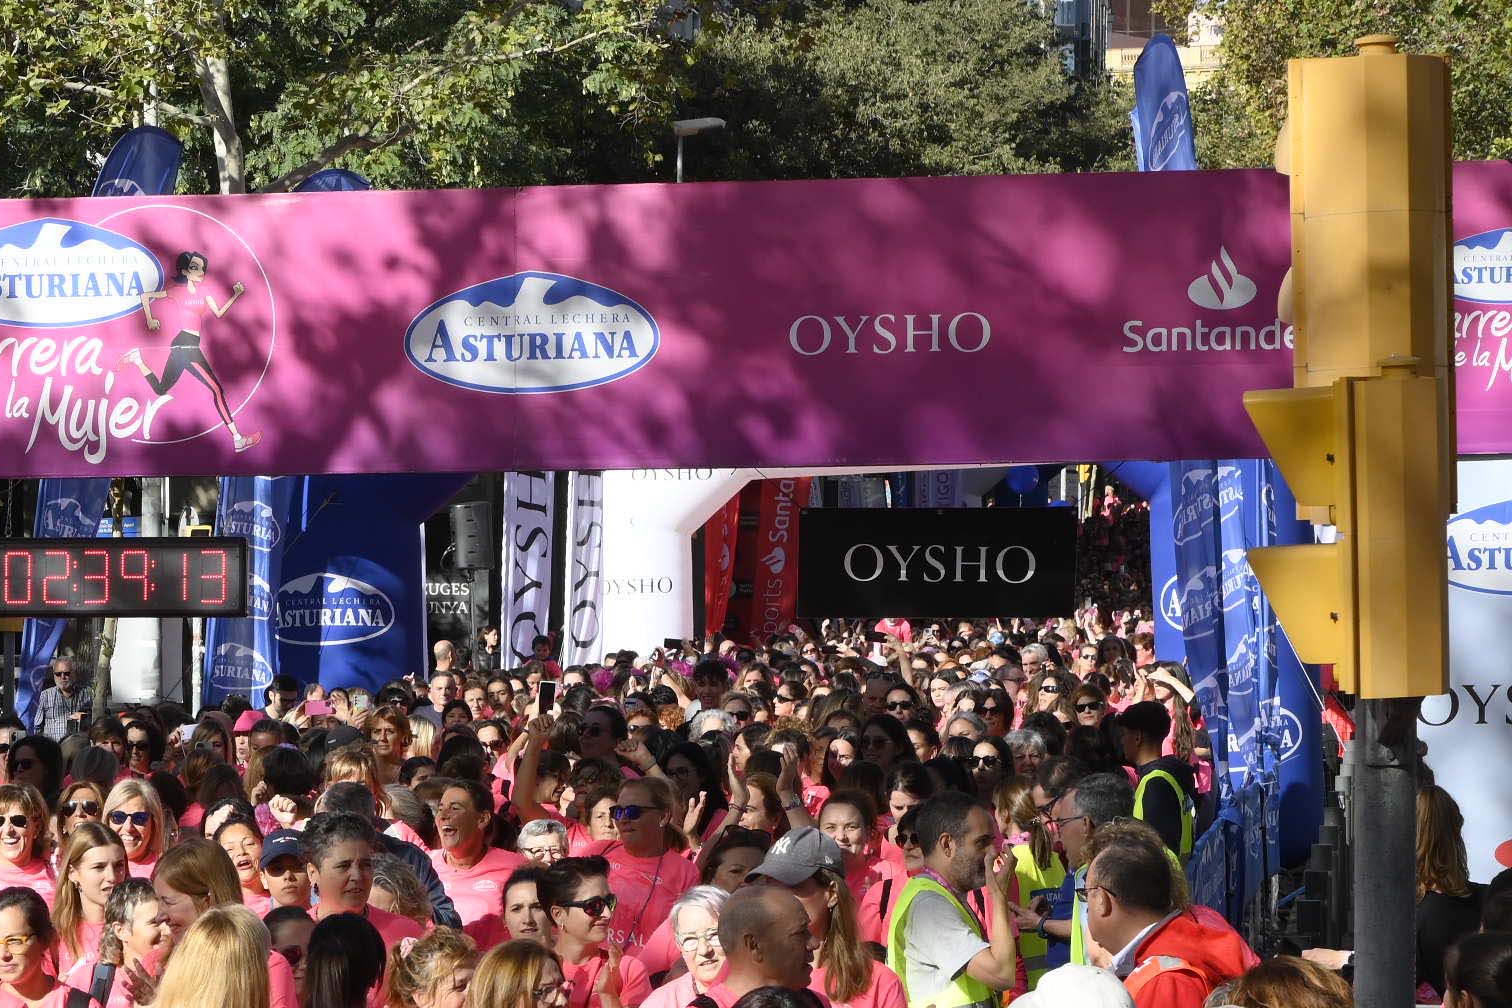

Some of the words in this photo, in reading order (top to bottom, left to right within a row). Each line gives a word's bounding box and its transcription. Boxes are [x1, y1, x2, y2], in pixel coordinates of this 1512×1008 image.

[424, 319, 640, 363] ASTURIANA
[464, 314, 542, 327] CENTRAL
[551, 312, 632, 325] LECHERA
[789, 312, 991, 356] OYSHO
[1123, 319, 1294, 354] Santande
[5, 378, 31, 419] la
[25, 370, 174, 465] Mujer
[769, 479, 796, 543] Santa
[512, 471, 548, 664] OYSH
[571, 470, 602, 648] OYSH
[843, 543, 1037, 585] OYSHO
[607, 927, 646, 949] RSAL
